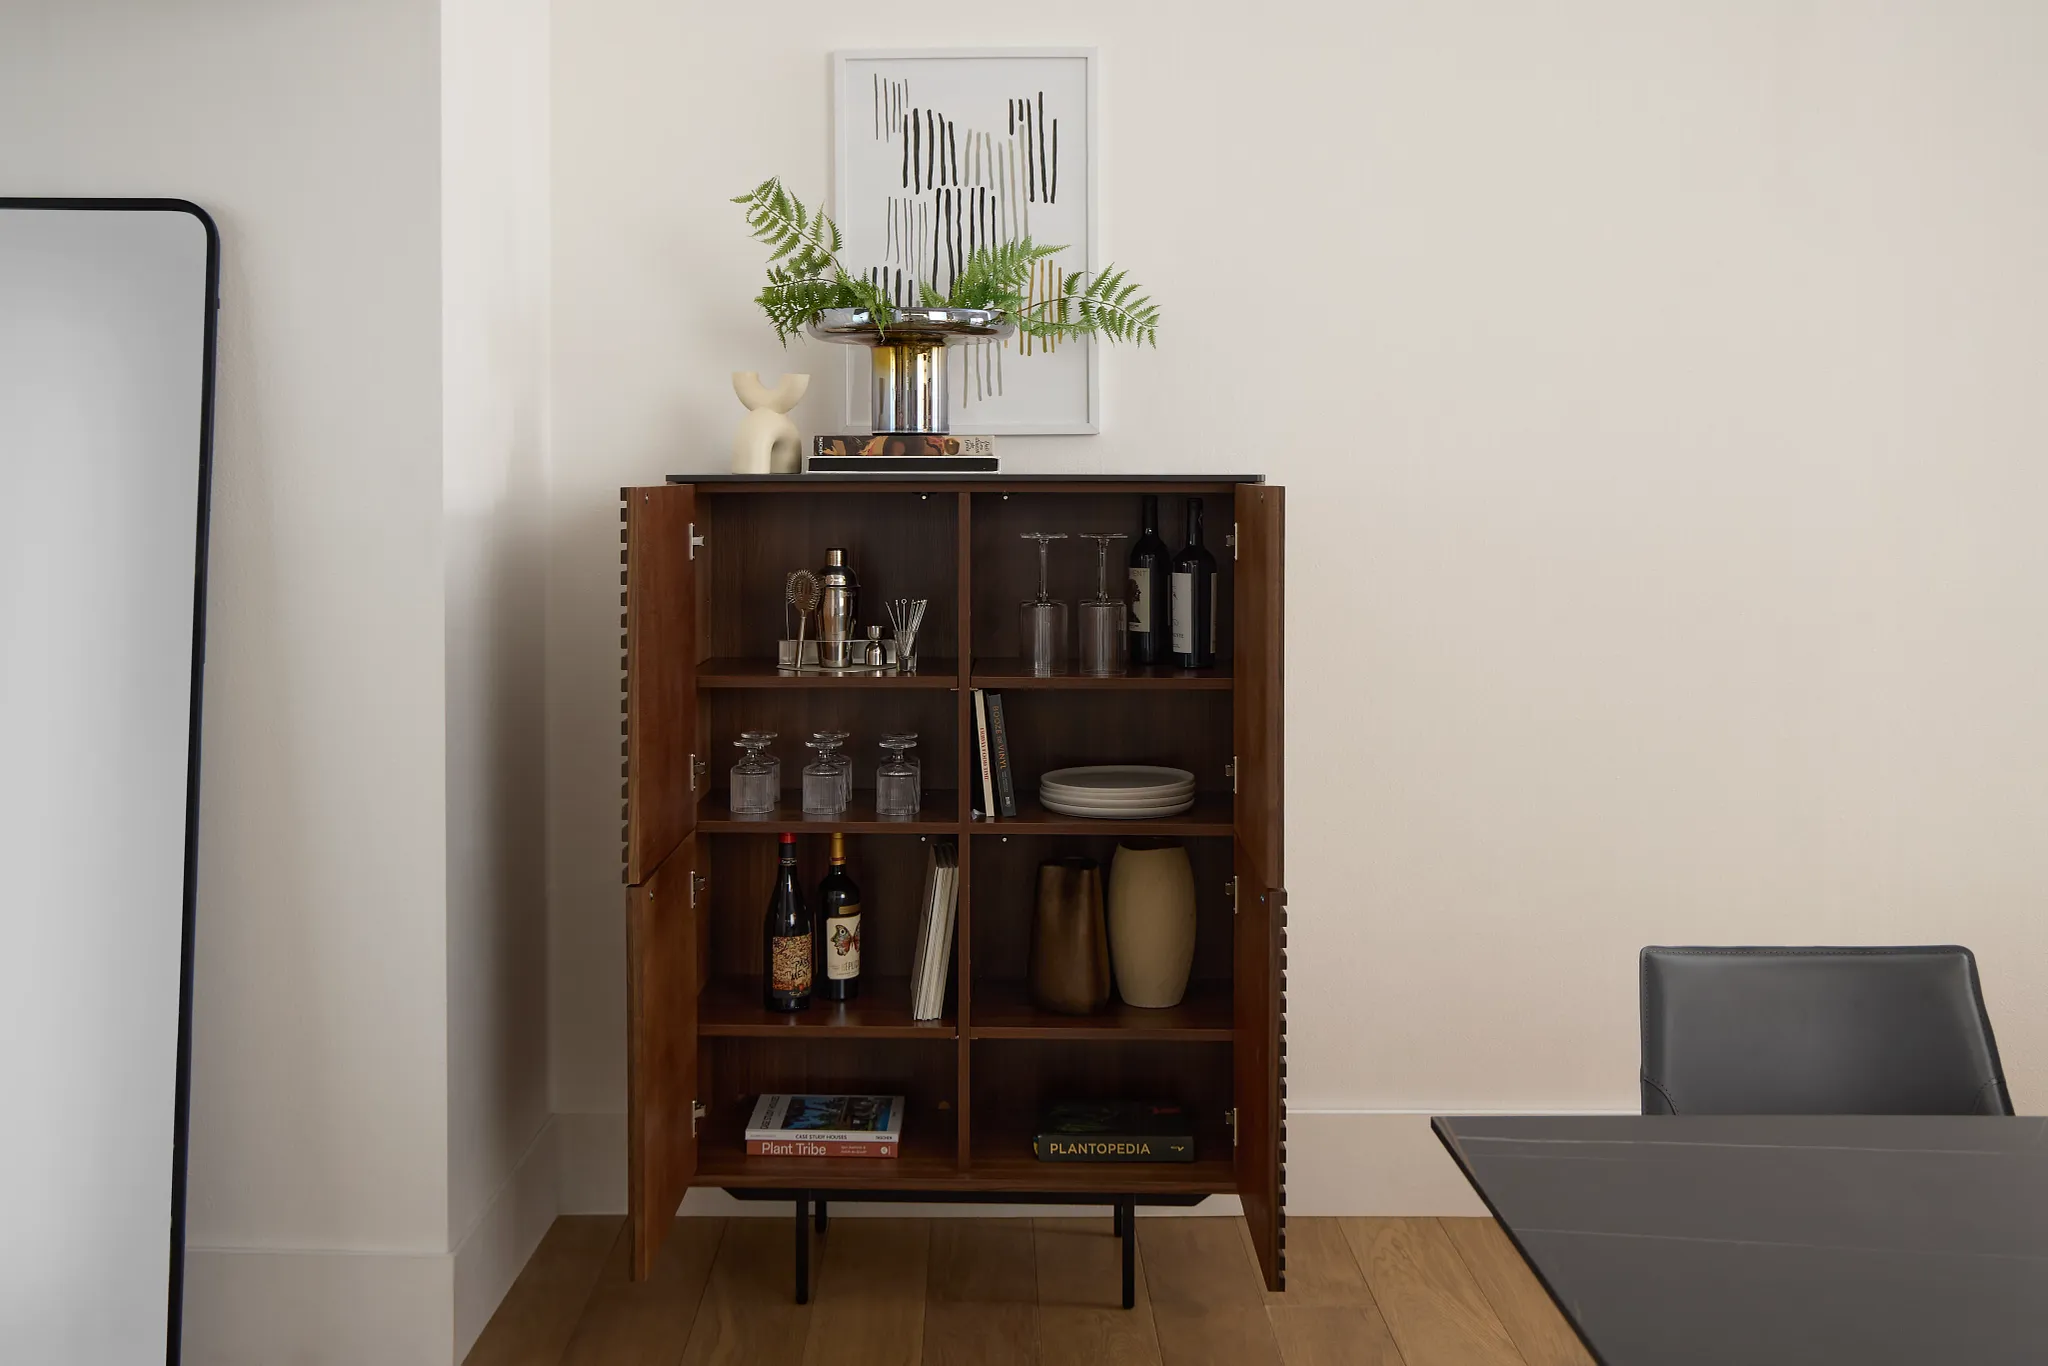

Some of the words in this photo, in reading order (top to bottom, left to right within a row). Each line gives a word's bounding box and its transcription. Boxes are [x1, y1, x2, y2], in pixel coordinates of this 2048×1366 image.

[993, 705, 1002, 734] BOOZE
[998, 745, 1007, 769] VINYL
[761, 1142, 793, 1155] Plant
[795, 1142, 827, 1155] Tribe
[1050, 1143, 1151, 1154] PLANTOPEDIA
